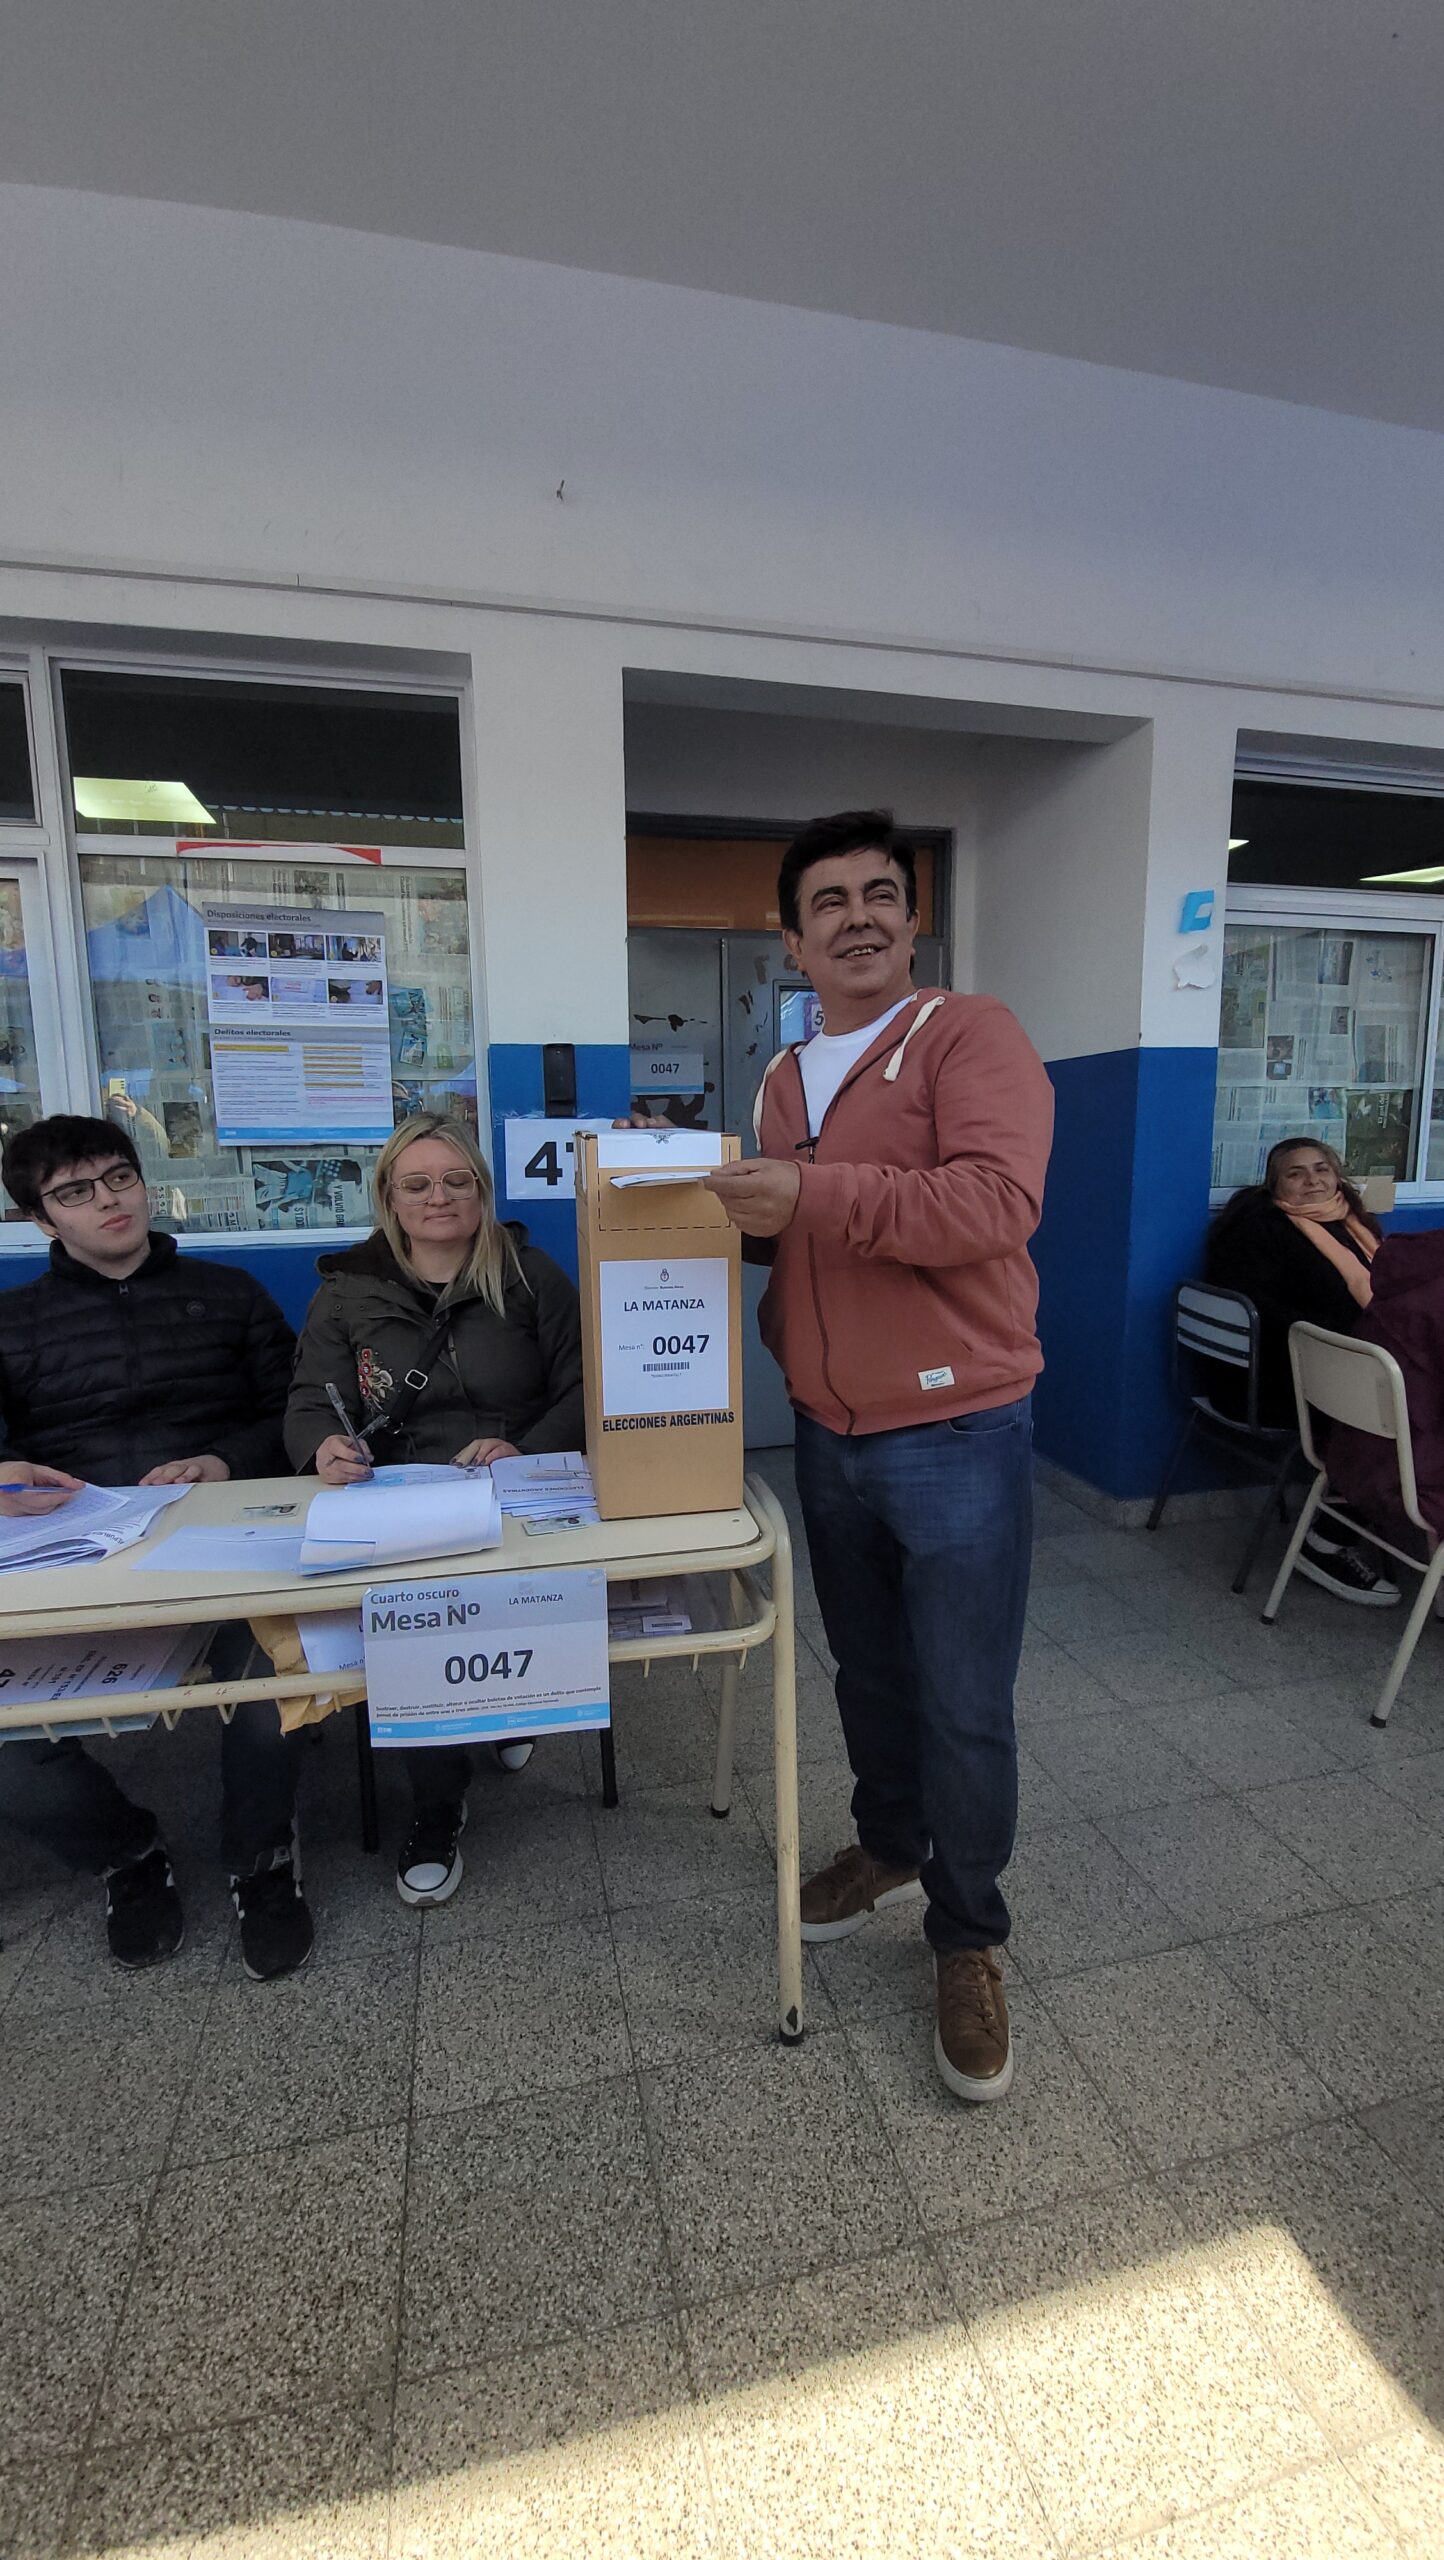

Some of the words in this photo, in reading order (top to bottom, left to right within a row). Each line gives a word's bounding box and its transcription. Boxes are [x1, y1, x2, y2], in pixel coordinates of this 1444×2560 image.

[207, 910, 264, 920] Disposiciones
[266, 913, 311, 922] electorales
[650, 1063, 680, 1074] 0047
[525, 1141, 575, 1186] 4
[624, 1300, 638, 1312] LA
[642, 1298, 705, 1312] MATANZA
[618, 1344, 636, 1352] Mesa
[652, 1334, 710, 1356] 0047
[602, 1415, 667, 1432] ELECCIONES
[669, 1411, 735, 1428] ARGENTINAS
[370, 1592, 414, 1605] Cuarto
[417, 1588, 459, 1601] oscuro
[509, 1597, 520, 1606] LA
[521, 1593, 564, 1605] MATANZA
[371, 1610, 441, 1633] Mesa
[101, 1663, 128, 1685] 626
[445, 1649, 534, 1685] 0047
